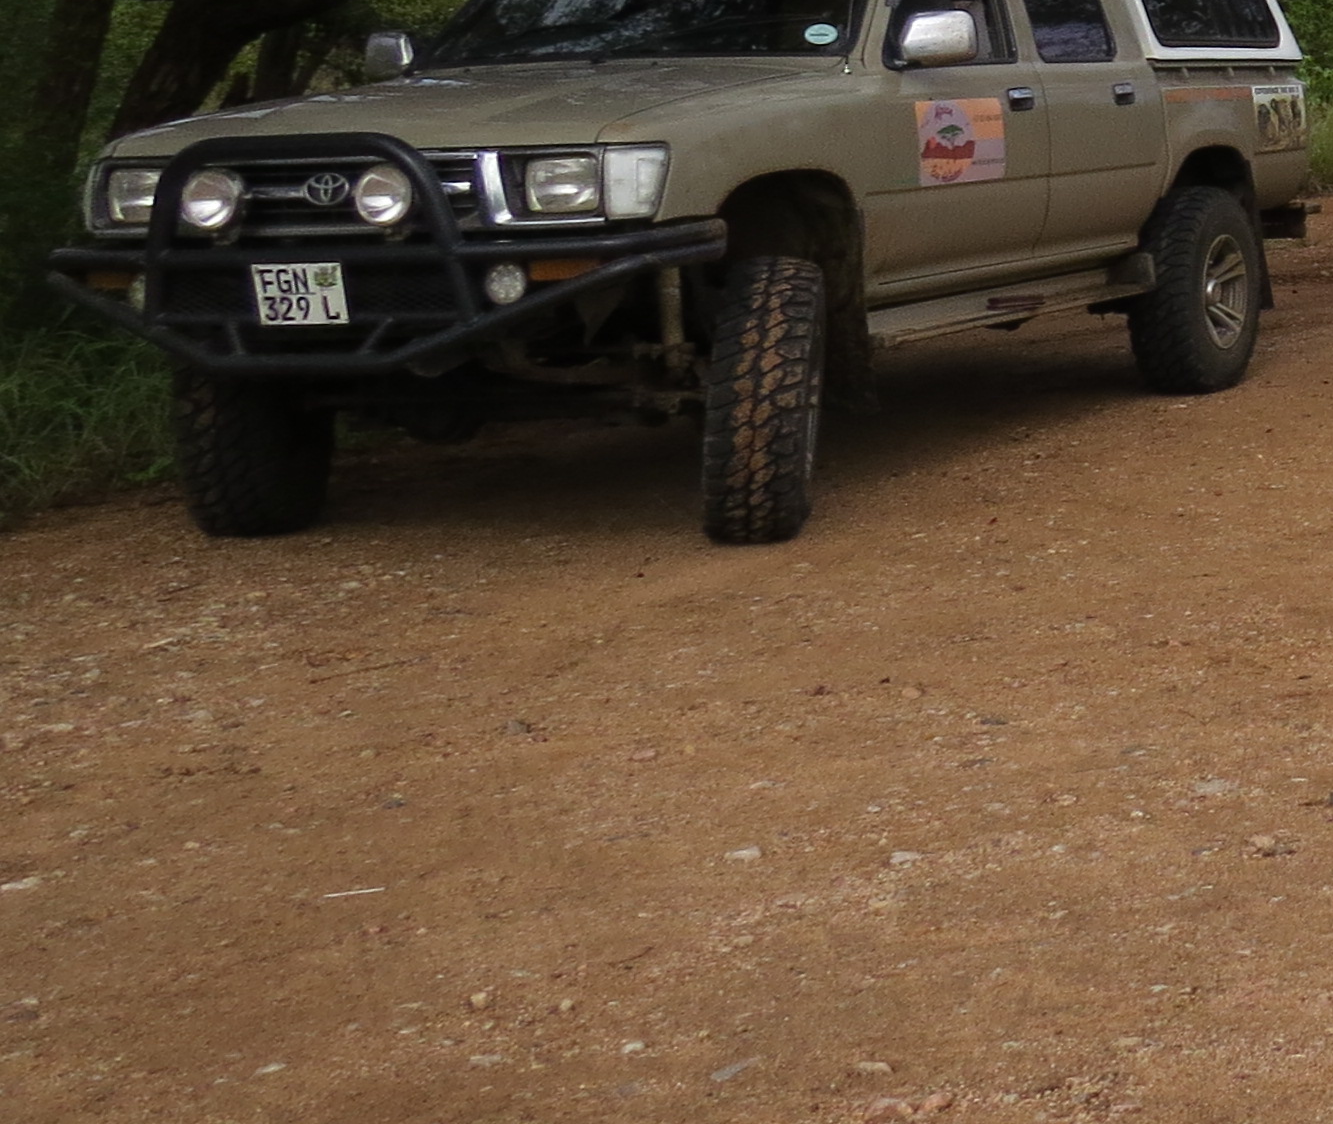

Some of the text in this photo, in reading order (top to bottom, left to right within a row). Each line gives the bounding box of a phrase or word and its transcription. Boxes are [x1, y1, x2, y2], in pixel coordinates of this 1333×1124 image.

[257, 268, 310, 294] FGN
[263, 295, 341, 321] 329 L
